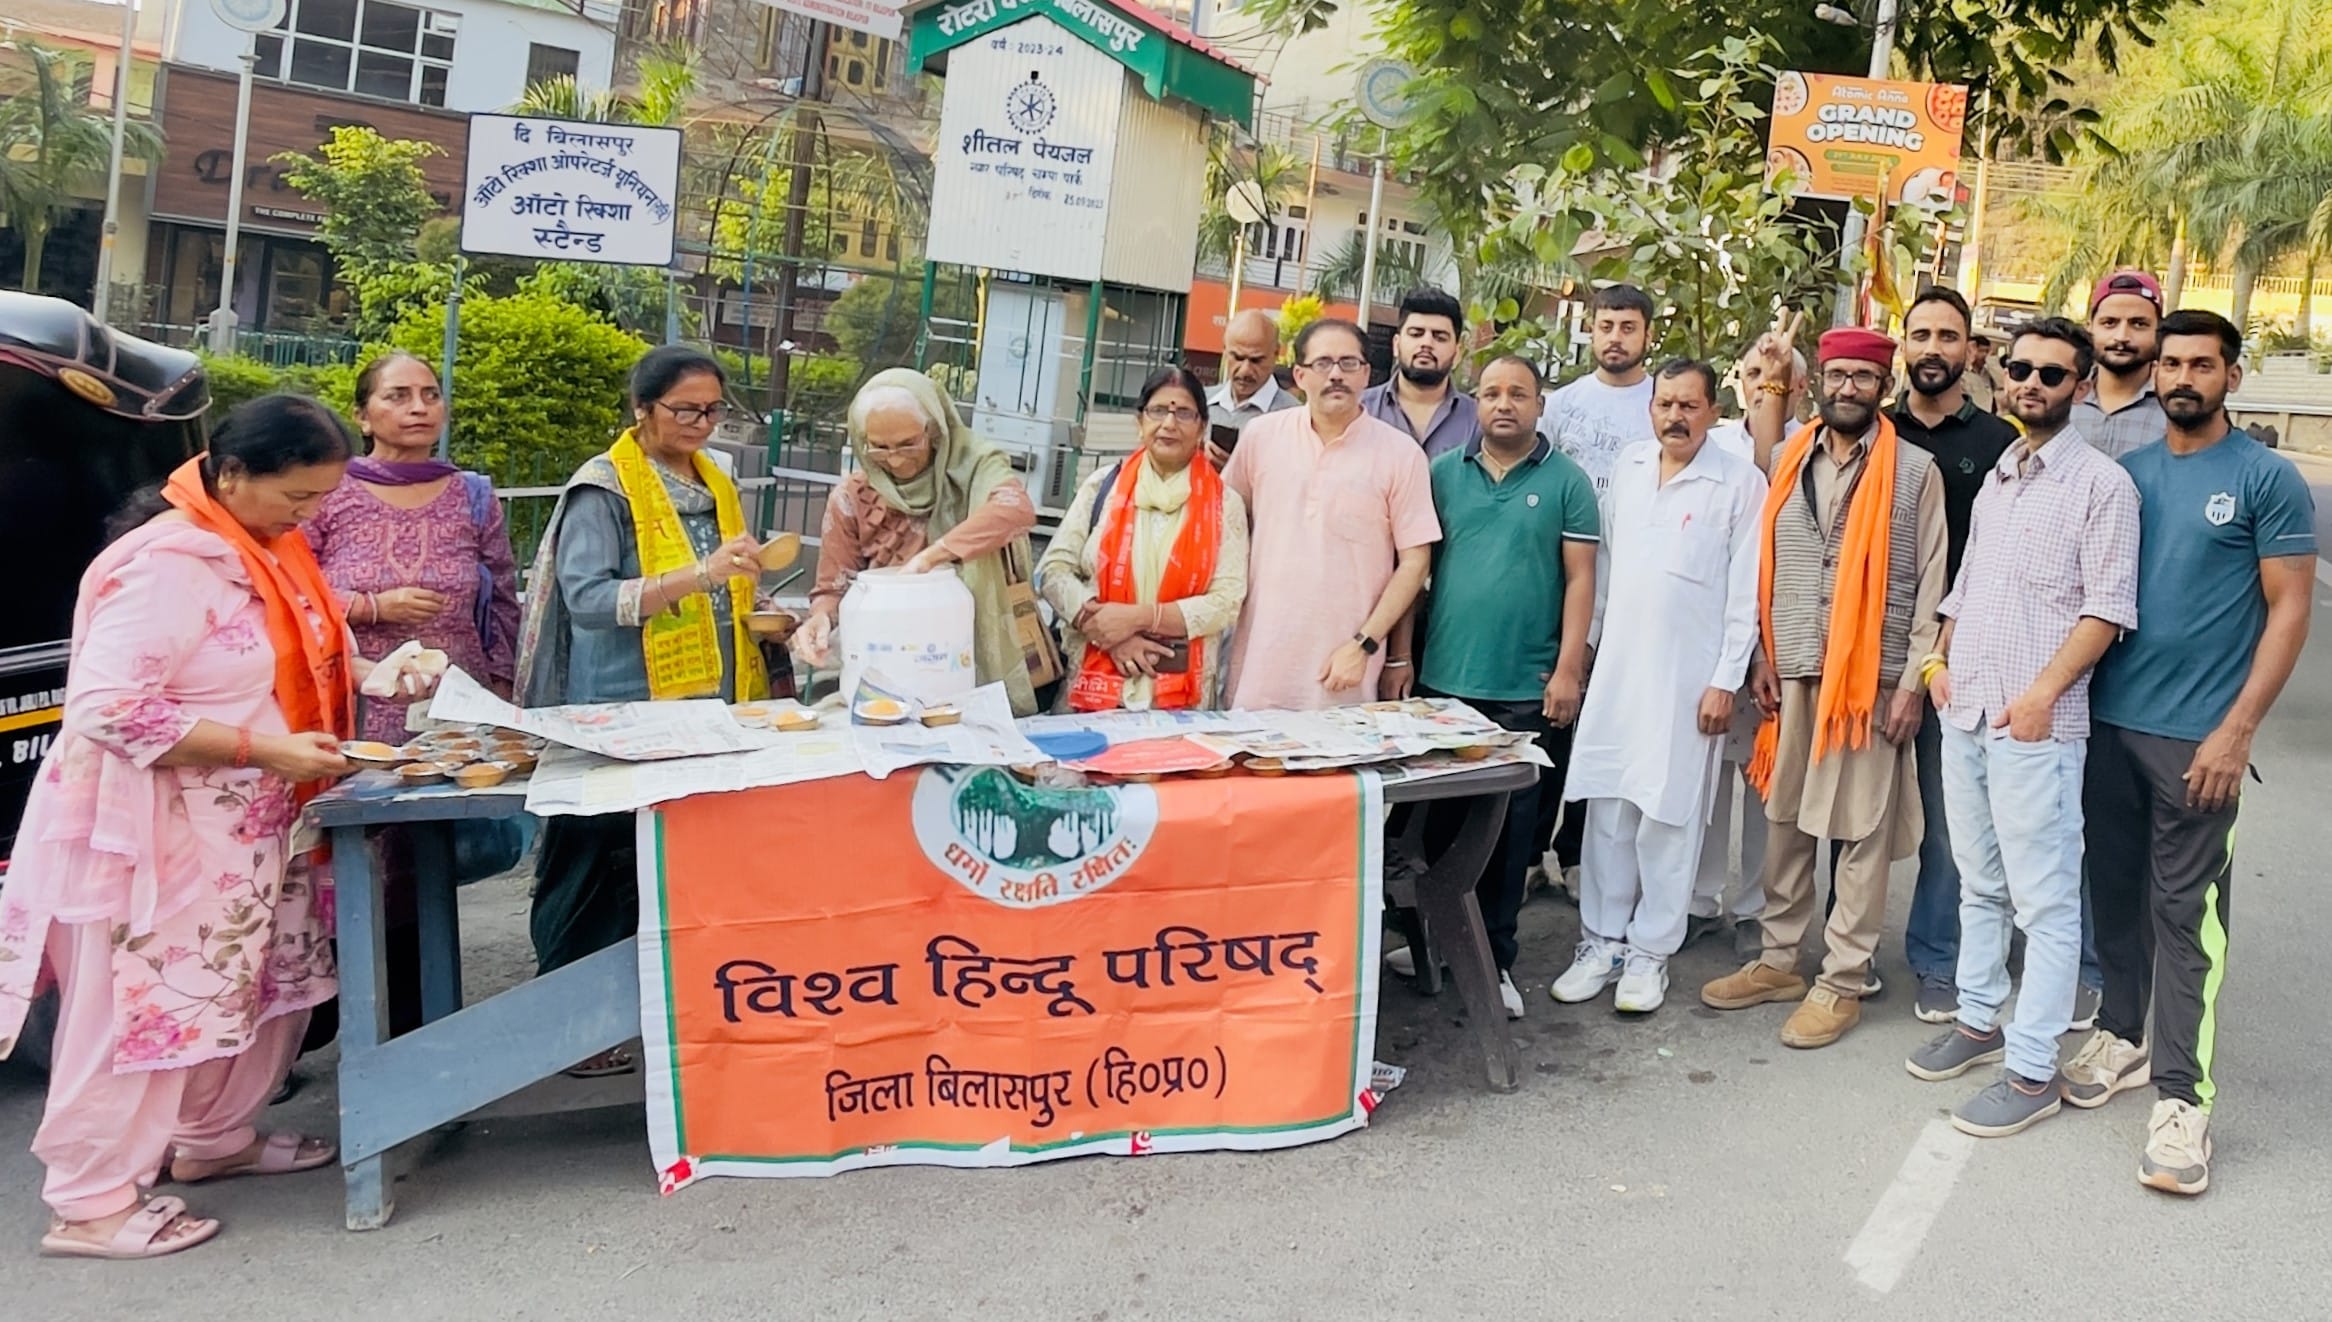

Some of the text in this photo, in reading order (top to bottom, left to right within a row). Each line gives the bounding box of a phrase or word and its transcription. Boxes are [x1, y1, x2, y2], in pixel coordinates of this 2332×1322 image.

[1817, 103, 1917, 129] GRAND
[514, 122, 634, 157] दि बिलासपुर
[962, 128, 1094, 164] शीतल पेयजल
[1806, 122, 1924, 152] OPENING
[616, 168, 660, 207] यूनियन
[272, 209, 316, 222] COMPLETE
[511, 192, 570, 216] ऑटो
[576, 194, 633, 221] रिक्शा
[1000, 872, 1058, 902] रक्षति
[714, 925, 1326, 1024] विश्व हिन्दू परिषद्
[825, 1068, 916, 1125] जिला
[924, 1053, 1072, 1129] बिलासपुर
